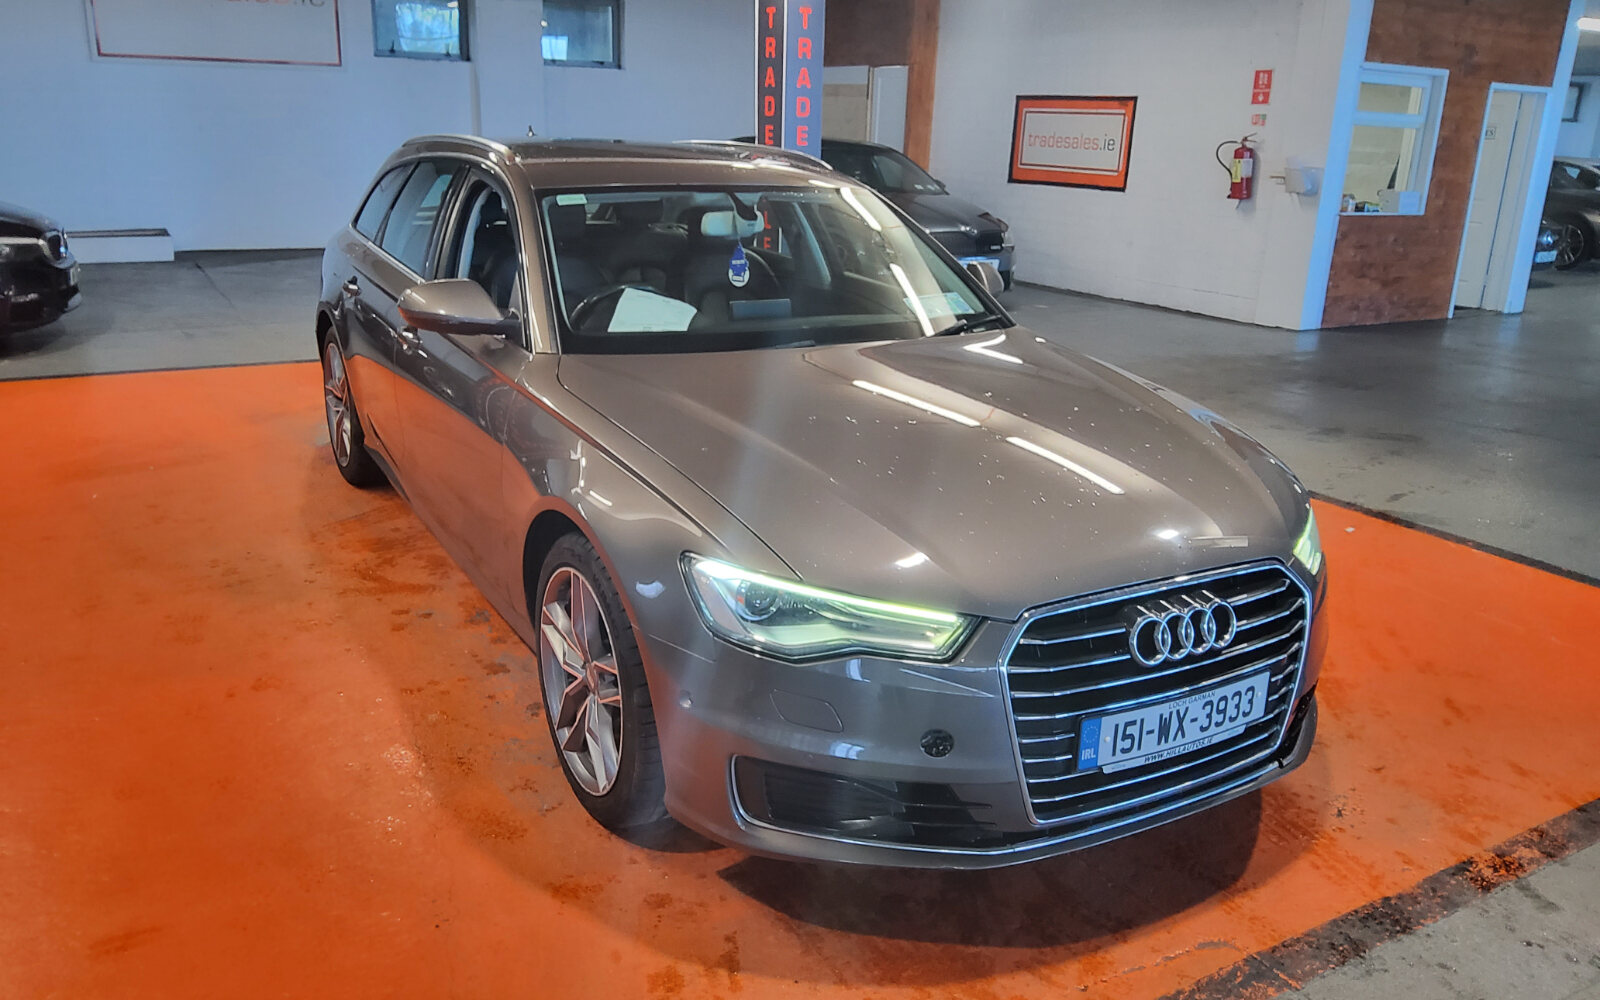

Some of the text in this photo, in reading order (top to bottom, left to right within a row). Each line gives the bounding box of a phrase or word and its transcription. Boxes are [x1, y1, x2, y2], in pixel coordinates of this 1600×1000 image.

[764, 6, 777, 145] TRADE
[796, 6, 812, 146] TRADE
[1027, 132, 1116, 151] tradesales.ie
[1111, 685, 1256, 757] 151-WX-3933
[1168, 690, 1216, 709] LOCH GARMAN
[1081, 747, 1097, 761] IRL
